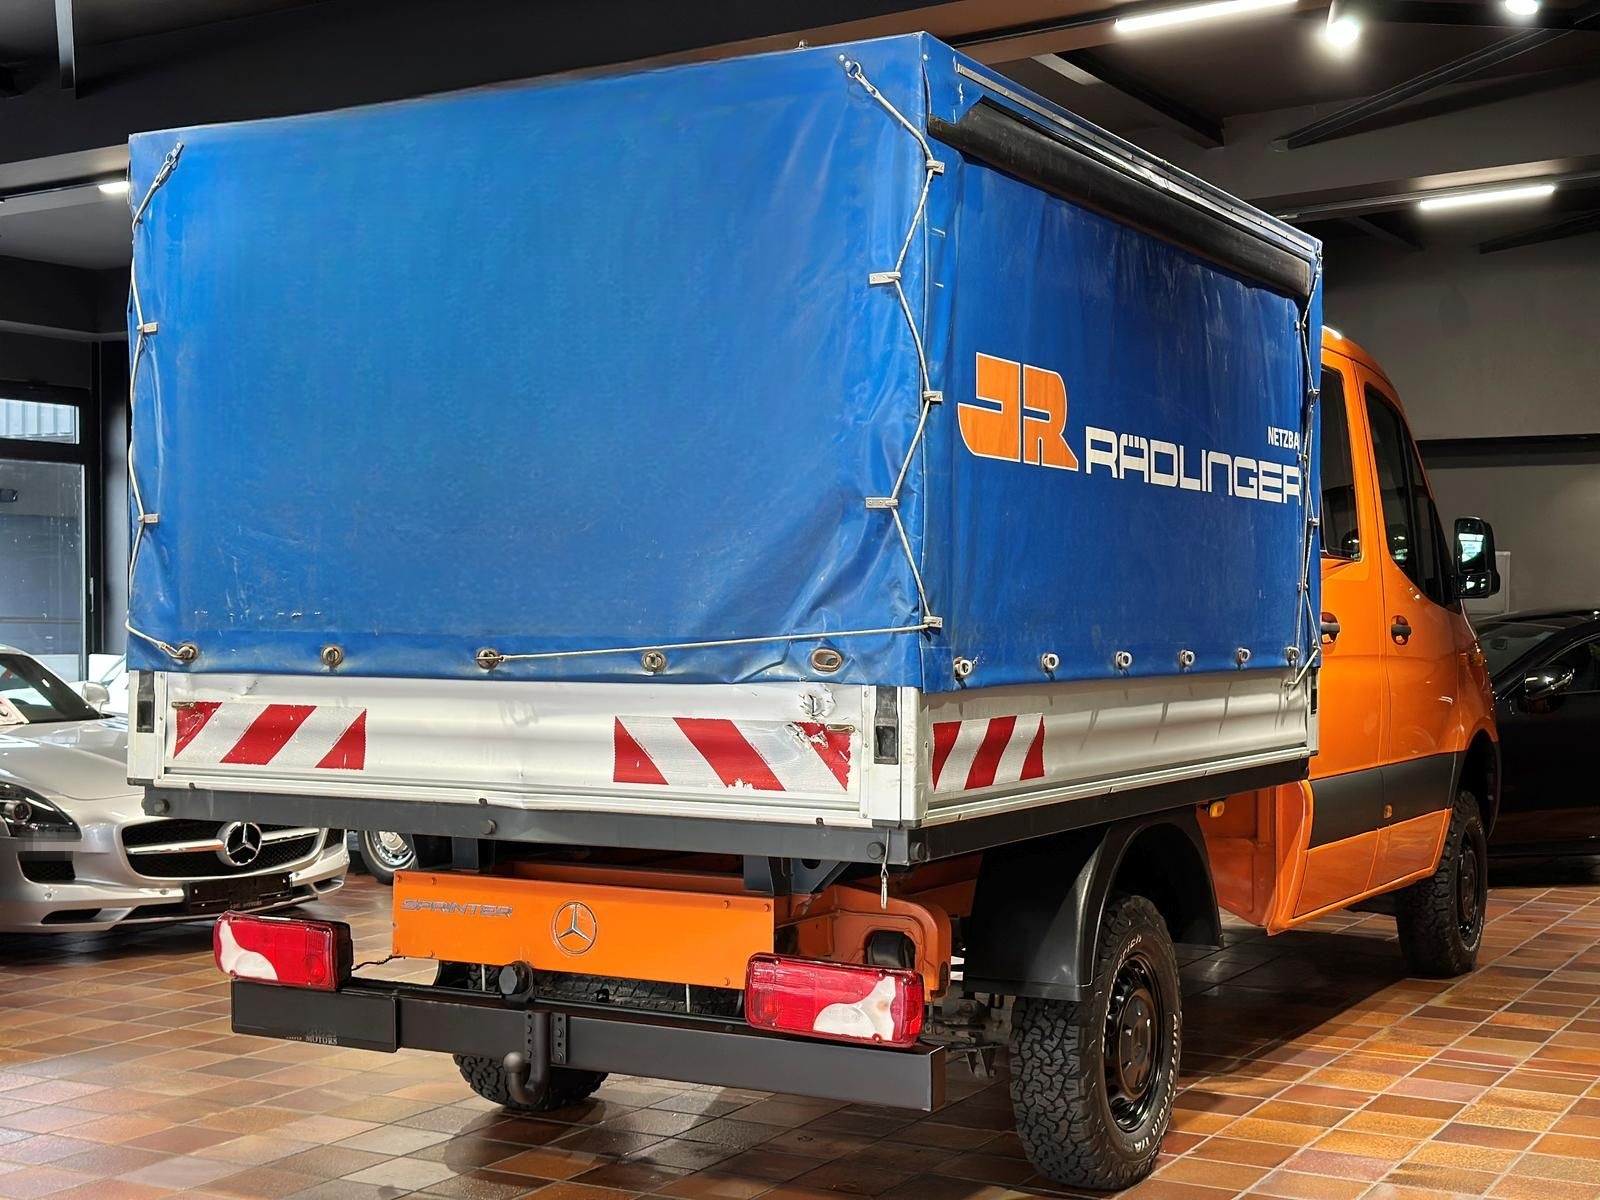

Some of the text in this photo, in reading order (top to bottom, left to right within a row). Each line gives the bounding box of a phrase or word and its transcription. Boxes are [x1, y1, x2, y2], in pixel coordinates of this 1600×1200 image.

[1267, 426, 1301, 451] NETZBA
[401, 898, 513, 919] SPRINTER
[305, 1034, 338, 1045] MOTORS
